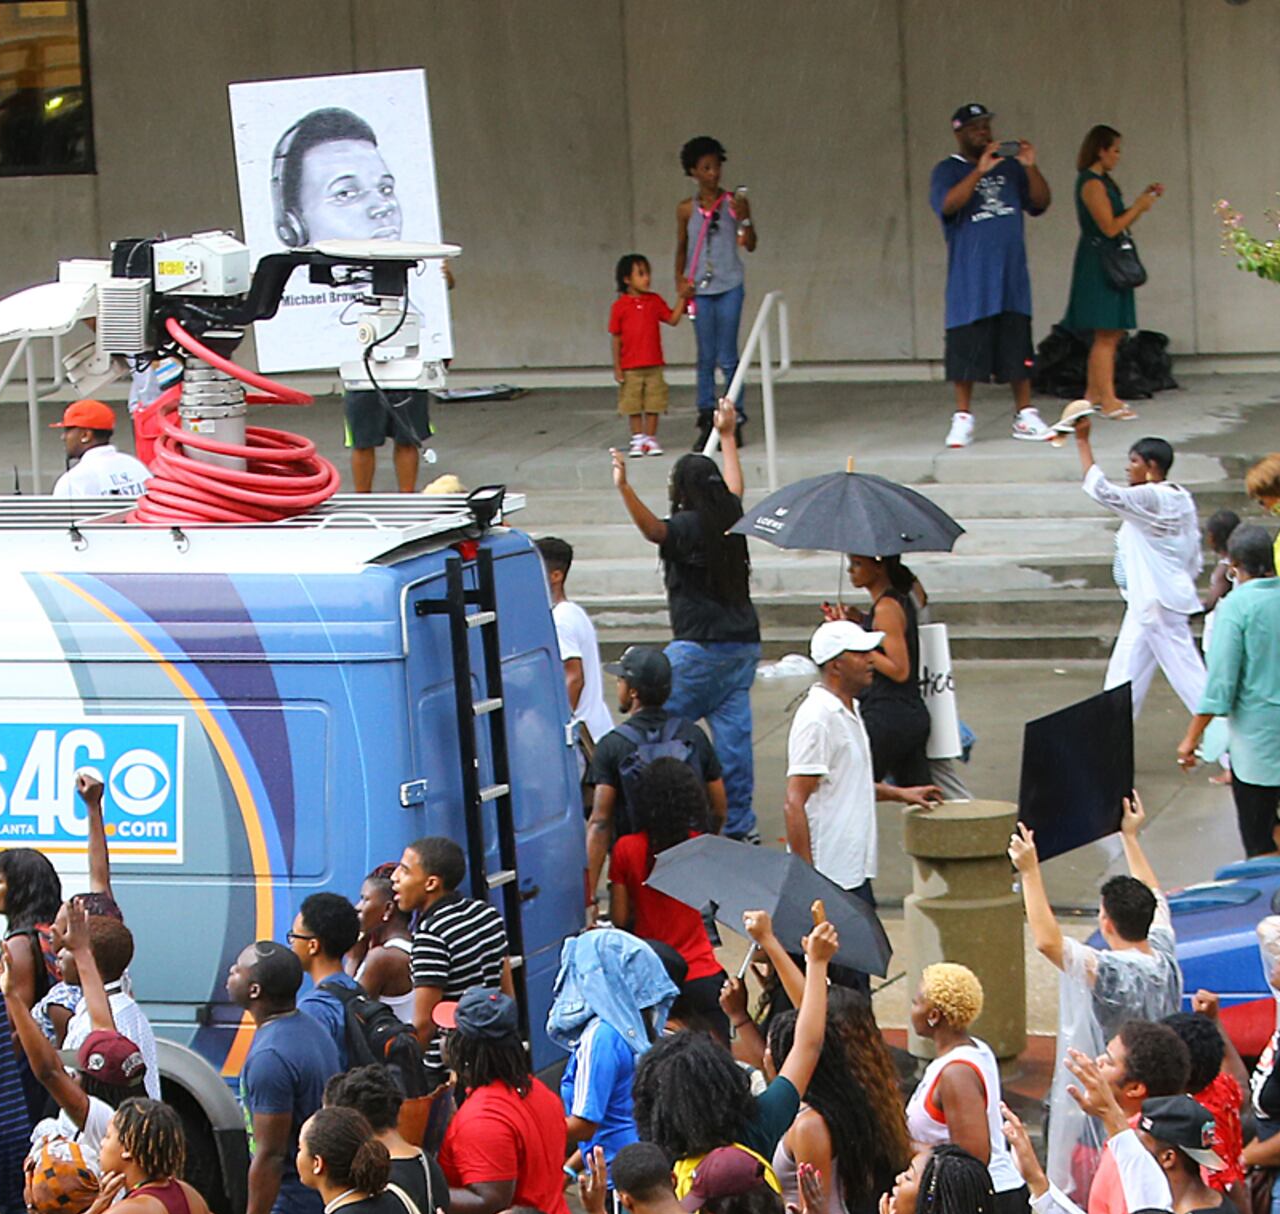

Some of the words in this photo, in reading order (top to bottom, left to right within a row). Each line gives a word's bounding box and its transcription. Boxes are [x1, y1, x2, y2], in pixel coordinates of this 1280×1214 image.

[282, 292, 327, 307] Michael
[329, 290, 366, 303] Brown
[104, 821, 168, 837] .com
